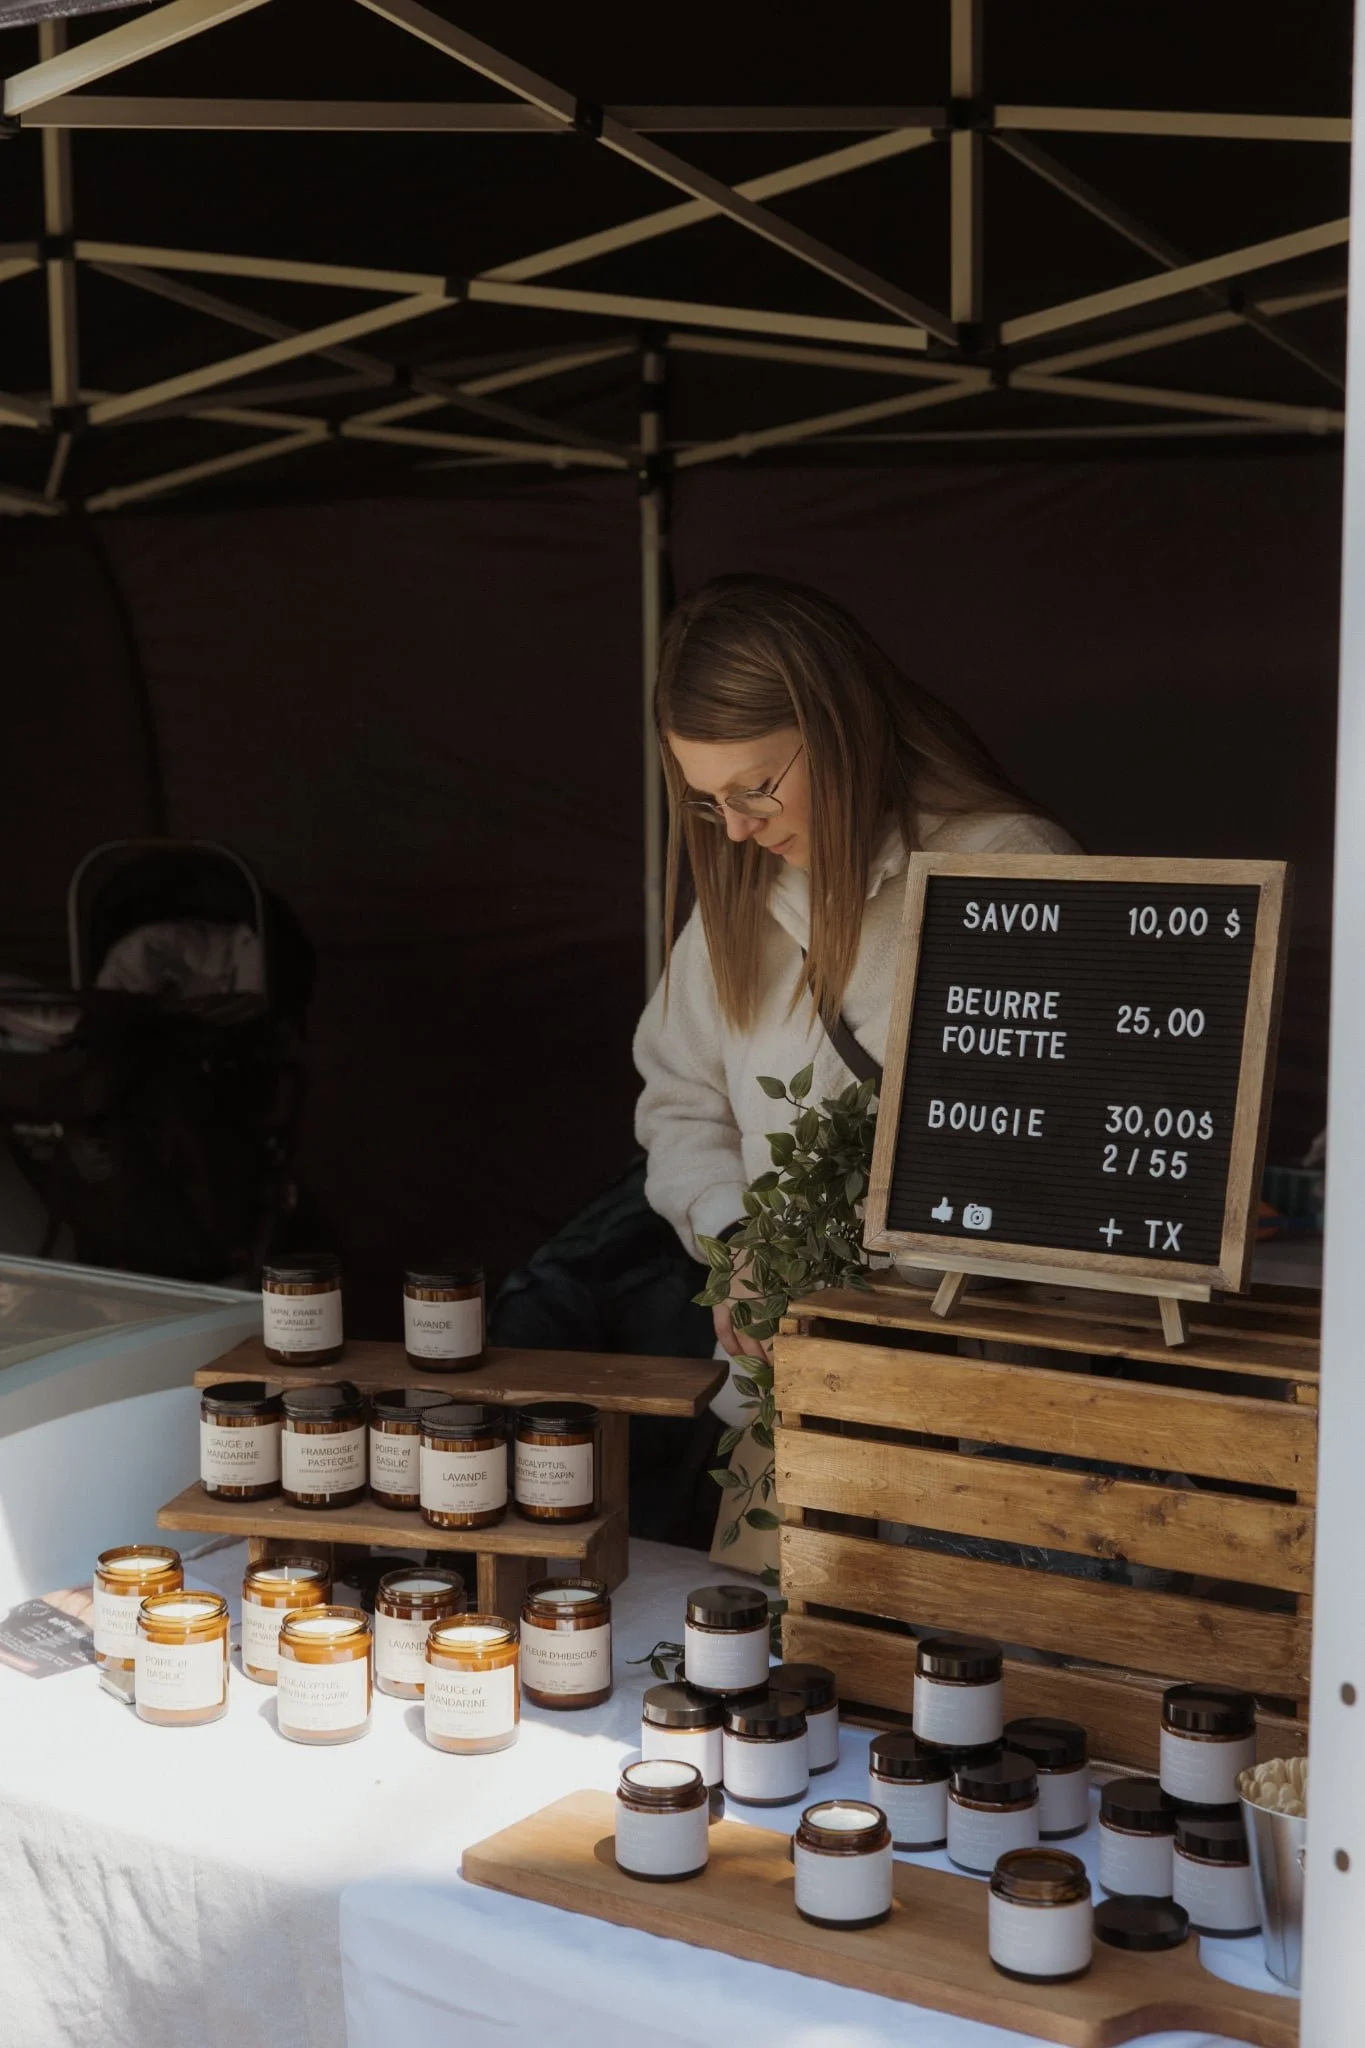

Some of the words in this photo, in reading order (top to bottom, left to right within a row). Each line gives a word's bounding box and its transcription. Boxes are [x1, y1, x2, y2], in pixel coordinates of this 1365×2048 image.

[962, 901, 1060, 933] SAVON
[1128, 905, 1209, 939] 10,00
[1223, 908, 1241, 939] $
[946, 985, 1061, 1020] BEURRE
[1116, 1004, 1205, 1039] 25,00
[942, 1025, 1068, 1060] FOUETTE
[927, 1099, 1045, 1137] BOUGIE
[1144, 1219, 1184, 1252] TX
[413, 1318, 454, 1330] LAVANDE
[210, 1438, 241, 1449] SAUGE
[244, 1440, 254, 1449] et
[375, 1443, 400, 1456] POIRE
[401, 1448, 411, 1456] et
[207, 1449, 261, 1460] MANDARINE
[301, 1445, 352, 1456] FRAMBOISE
[376, 1455, 409, 1469] BASILIC
[442, 1471, 488, 1482] LAVANDE
[539, 1471, 547, 1479] et
[548, 1471, 575, 1480] SAPIN
[389, 1639, 426, 1651] LAVAND
[525, 1644, 547, 1658] FLEUR
[549, 1649, 598, 1661] D'HIBISCUS
[145, 1655, 174, 1668] POIRE
[146, 1668, 185, 1681] BASILIC
[434, 1680, 468, 1695] SAUGE
[430, 1692, 488, 1708] MANDARINE
